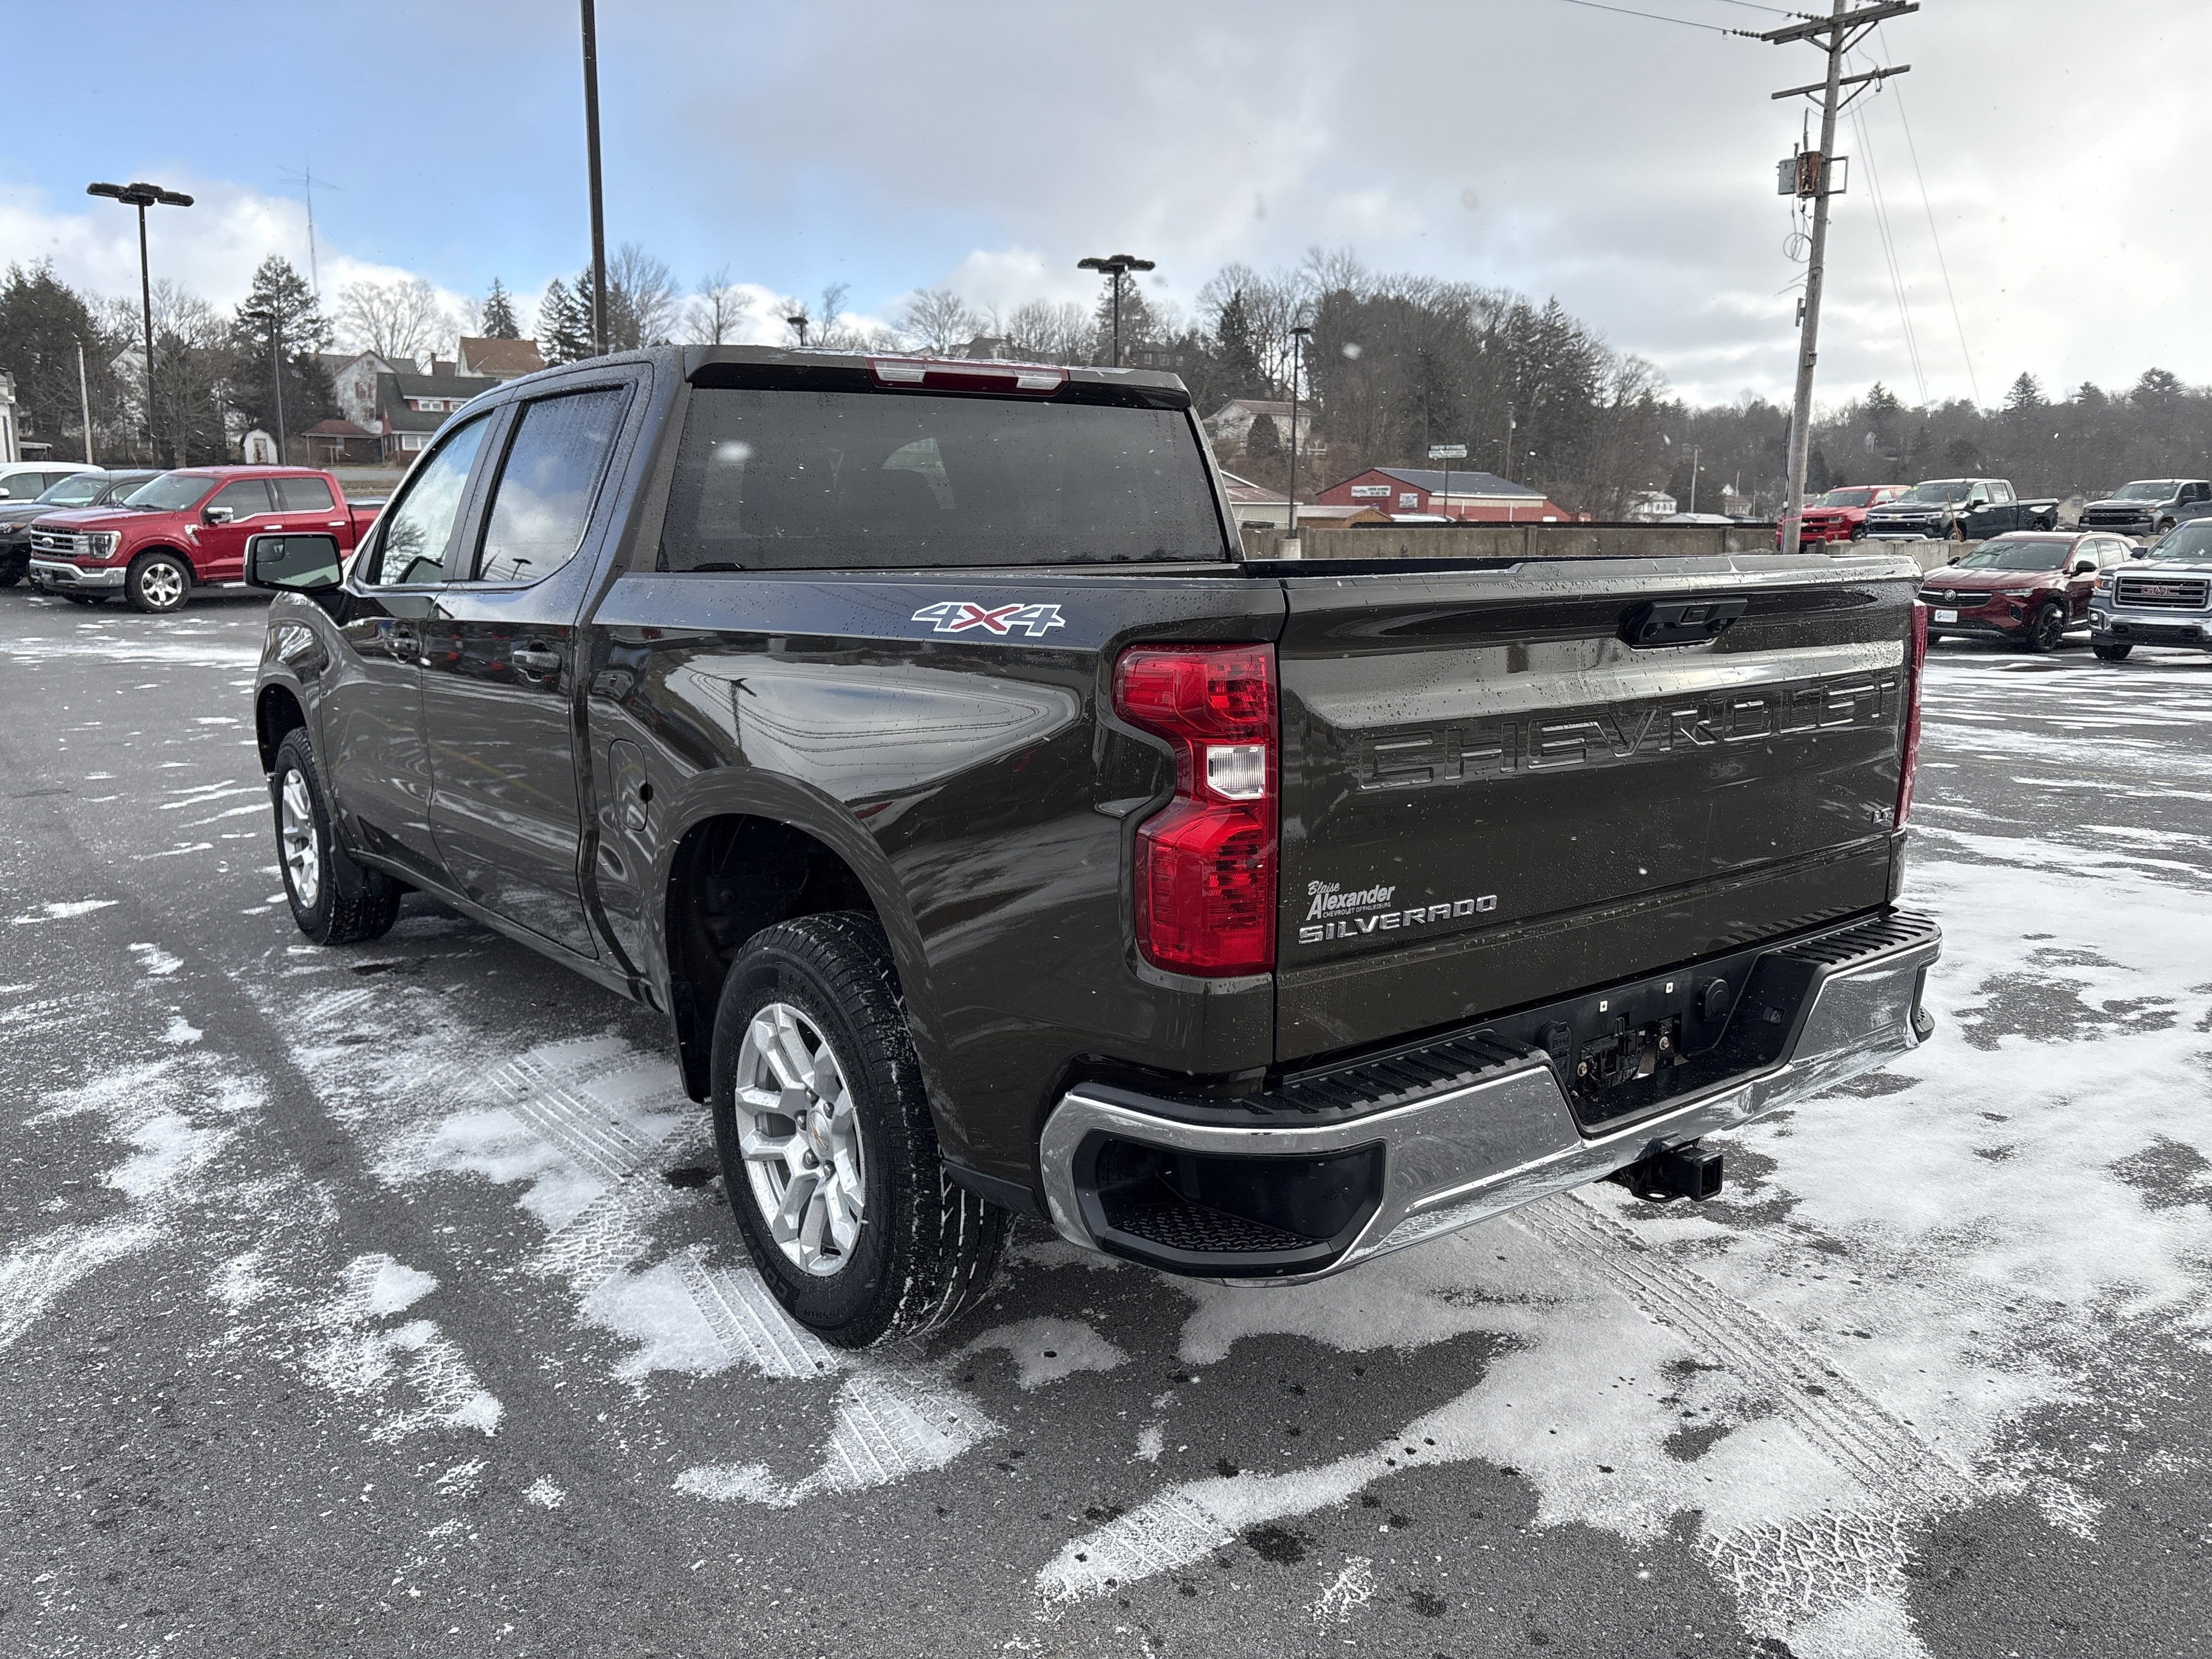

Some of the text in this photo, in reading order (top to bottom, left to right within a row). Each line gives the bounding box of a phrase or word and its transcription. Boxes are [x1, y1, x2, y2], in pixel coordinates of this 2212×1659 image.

[2141, 586, 2180, 596] GMC
[1359, 679, 1897, 791] CHEVROLET
[1872, 806, 1892, 824] LT
[1307, 880, 1341, 896] Blaise
[1305, 884, 1396, 922] Alexander
[1322, 901, 1392, 919] CHEVROLET OF PHILIPSBURG
[1298, 894, 1498, 945] SILVERADO
